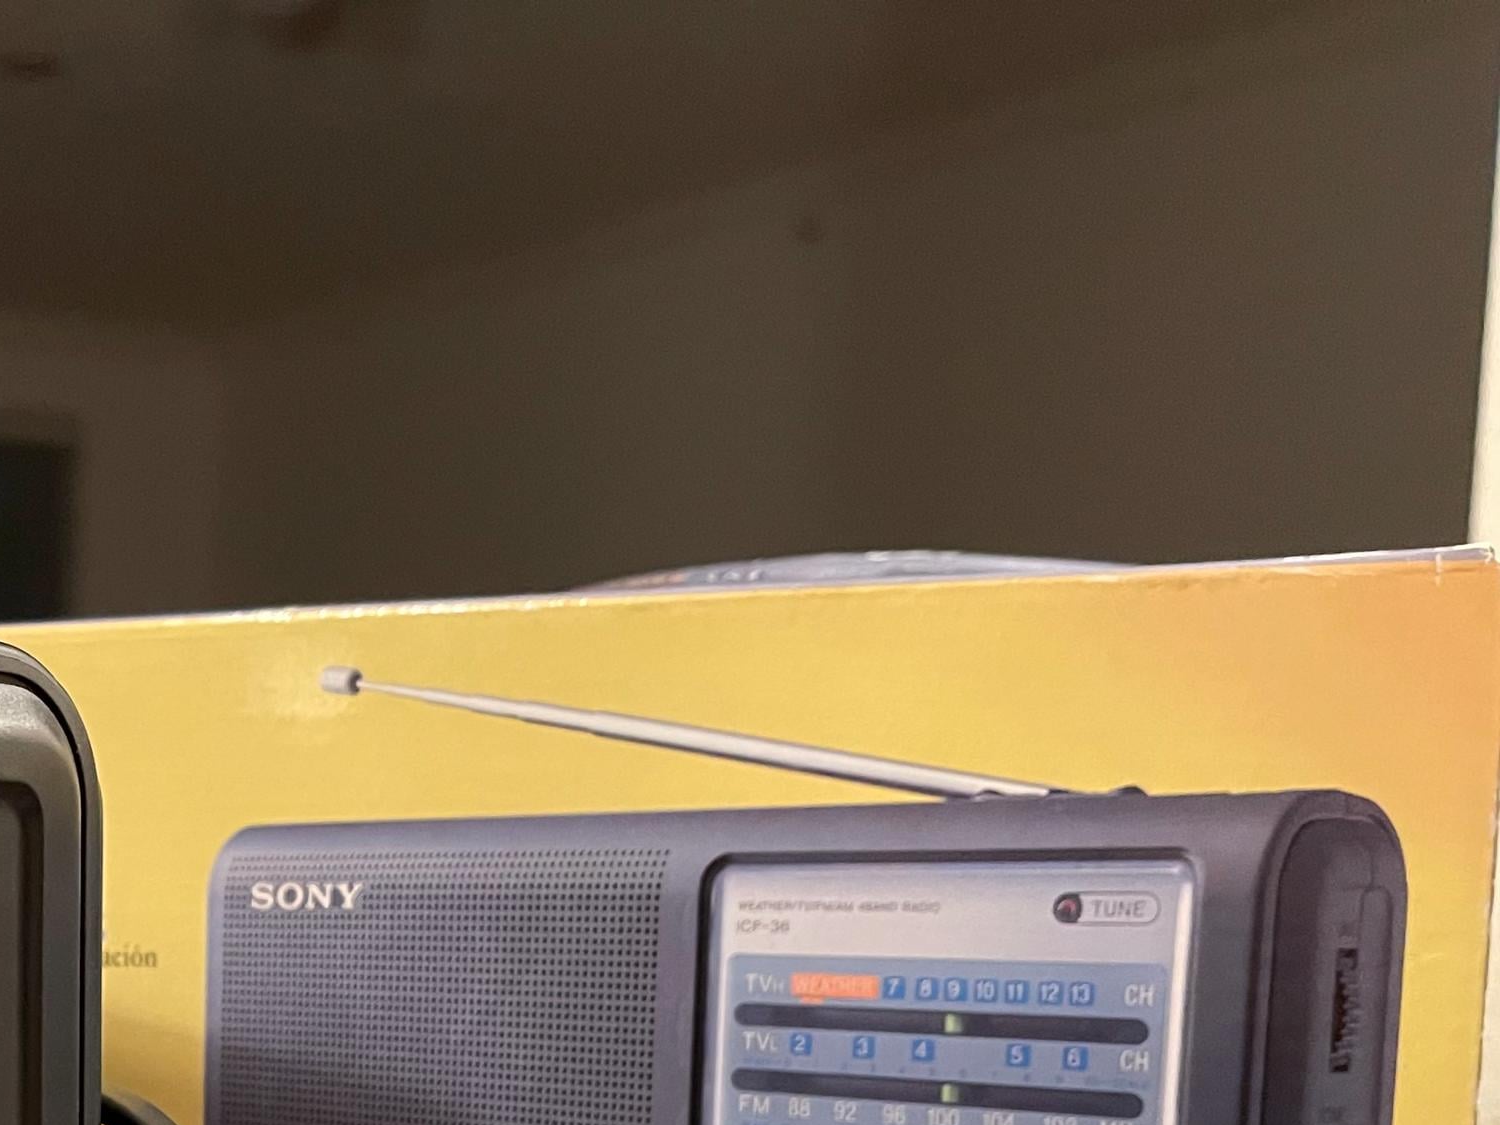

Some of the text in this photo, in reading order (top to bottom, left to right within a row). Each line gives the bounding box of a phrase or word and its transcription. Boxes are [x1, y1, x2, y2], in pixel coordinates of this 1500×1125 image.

[251, 881, 364, 911] SONY
[1091, 900, 1147, 918] TUNE
[736, 919, 790, 933] ICF-36
[887, 978, 899, 995] 7
[919, 979, 932, 996] 8
[948, 980, 961, 997] 9
[977, 981, 995, 998] 10
[1007, 983, 1024, 999] 11
[1040, 984, 1060, 1001] 12
[1071, 984, 1090, 1001] 13
[1124, 984, 1155, 1006] CH
[794, 1034, 806, 1052] 2
[915, 1040, 929, 1058] 4
[1009, 1046, 1022, 1064] 5
[1067, 1048, 1080, 1067] 6
[1120, 1049, 1149, 1072] CH
[738, 1094, 770, 1113] FM
[834, 1100, 857, 1123] 92
